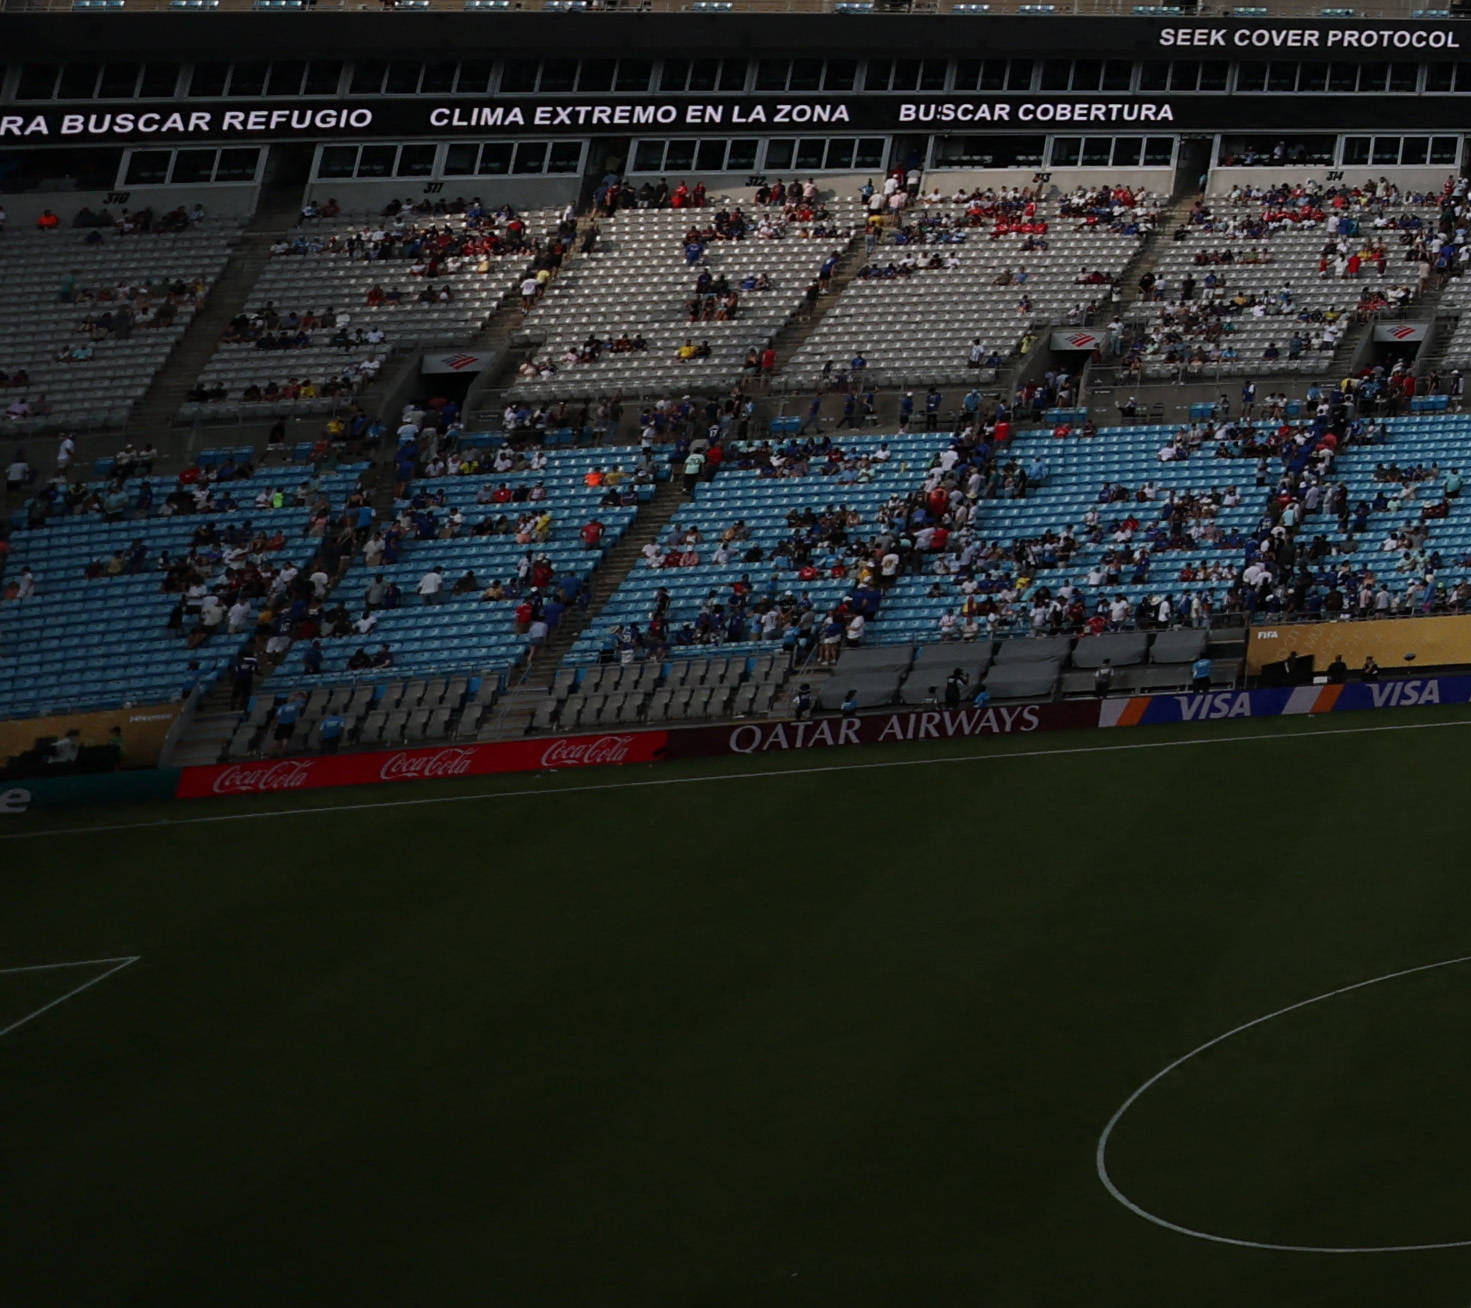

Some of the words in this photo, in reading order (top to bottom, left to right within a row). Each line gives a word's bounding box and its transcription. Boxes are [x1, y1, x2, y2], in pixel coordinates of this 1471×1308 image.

[1159, 28, 1227, 46] SEEK
[1233, 29, 1320, 47] COVER
[1326, 30, 1460, 48] PROTOCOL
[60, 112, 212, 135] BUSCAR
[222, 108, 373, 131] REFUGIO
[430, 106, 525, 127] CLIMA
[533, 105, 677, 125] EXTREMO
[685, 105, 724, 123] EN
[731, 104, 767, 123] LA
[773, 104, 850, 123] ZONA
[898, 103, 1011, 122] BUSCAR
[1018, 103, 1174, 121] COBERTURA
[423, 182, 444, 193] 311
[745, 176, 766, 188] 312
[103, 192, 130, 205] 310
[1174, 690, 1252, 721] VISA
[1368, 679, 1442, 709] VISA
[728, 718, 862, 755] QATAR
[878, 704, 1041, 743] AIRWAYS
[379, 745, 480, 781] Coca-Cola
[540, 735, 638, 767] Coca-Cola
[211, 760, 318, 794] Coca-Cola
